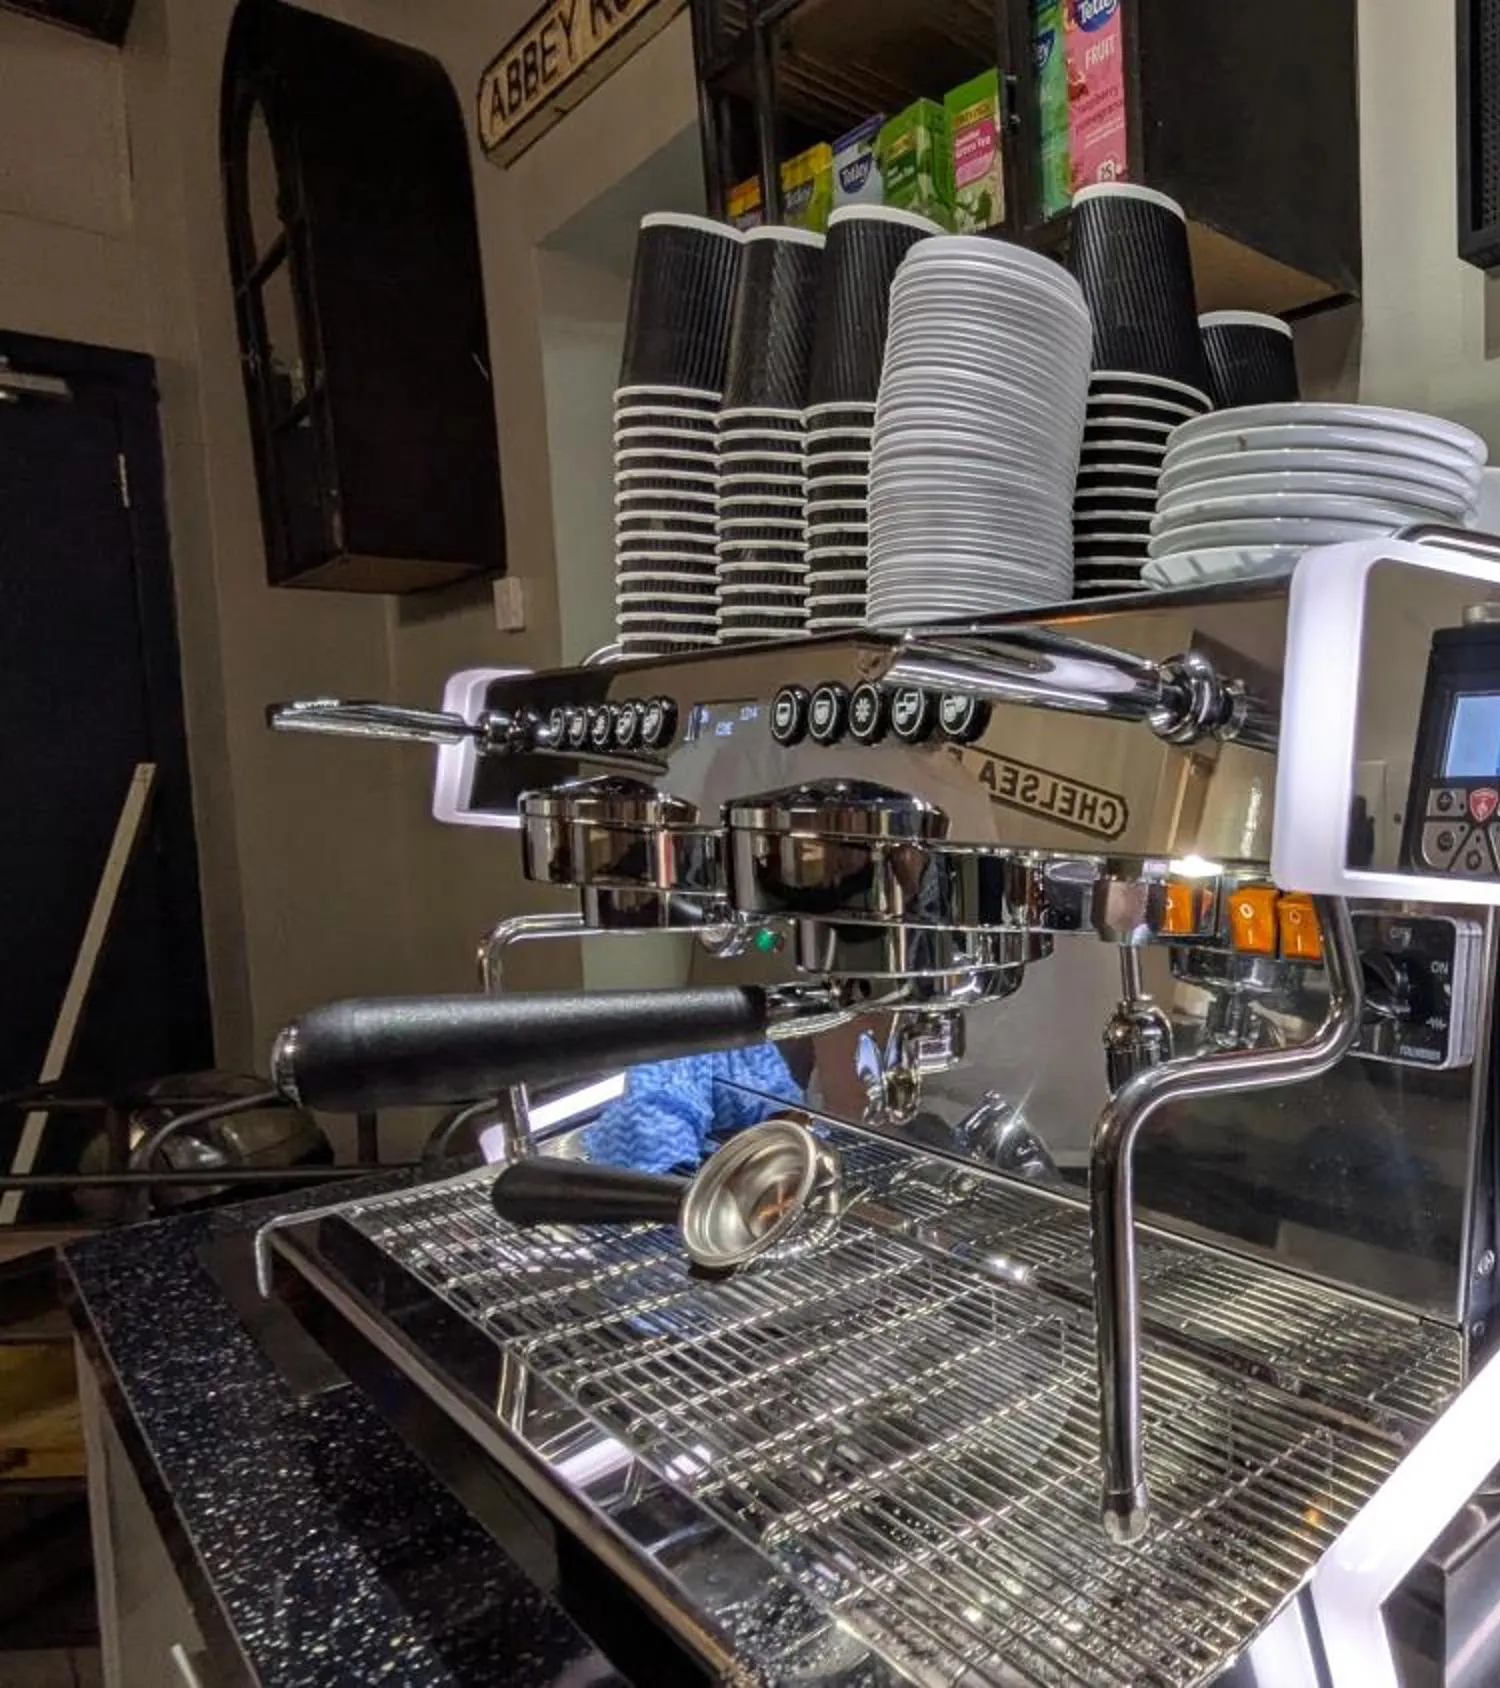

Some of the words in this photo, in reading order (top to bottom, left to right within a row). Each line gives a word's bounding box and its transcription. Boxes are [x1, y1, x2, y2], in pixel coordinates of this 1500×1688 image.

[490, 0, 577, 135] ABBEY
[1085, 34, 1116, 70] FRUIT
[1431, 960, 1449, 975] ON
